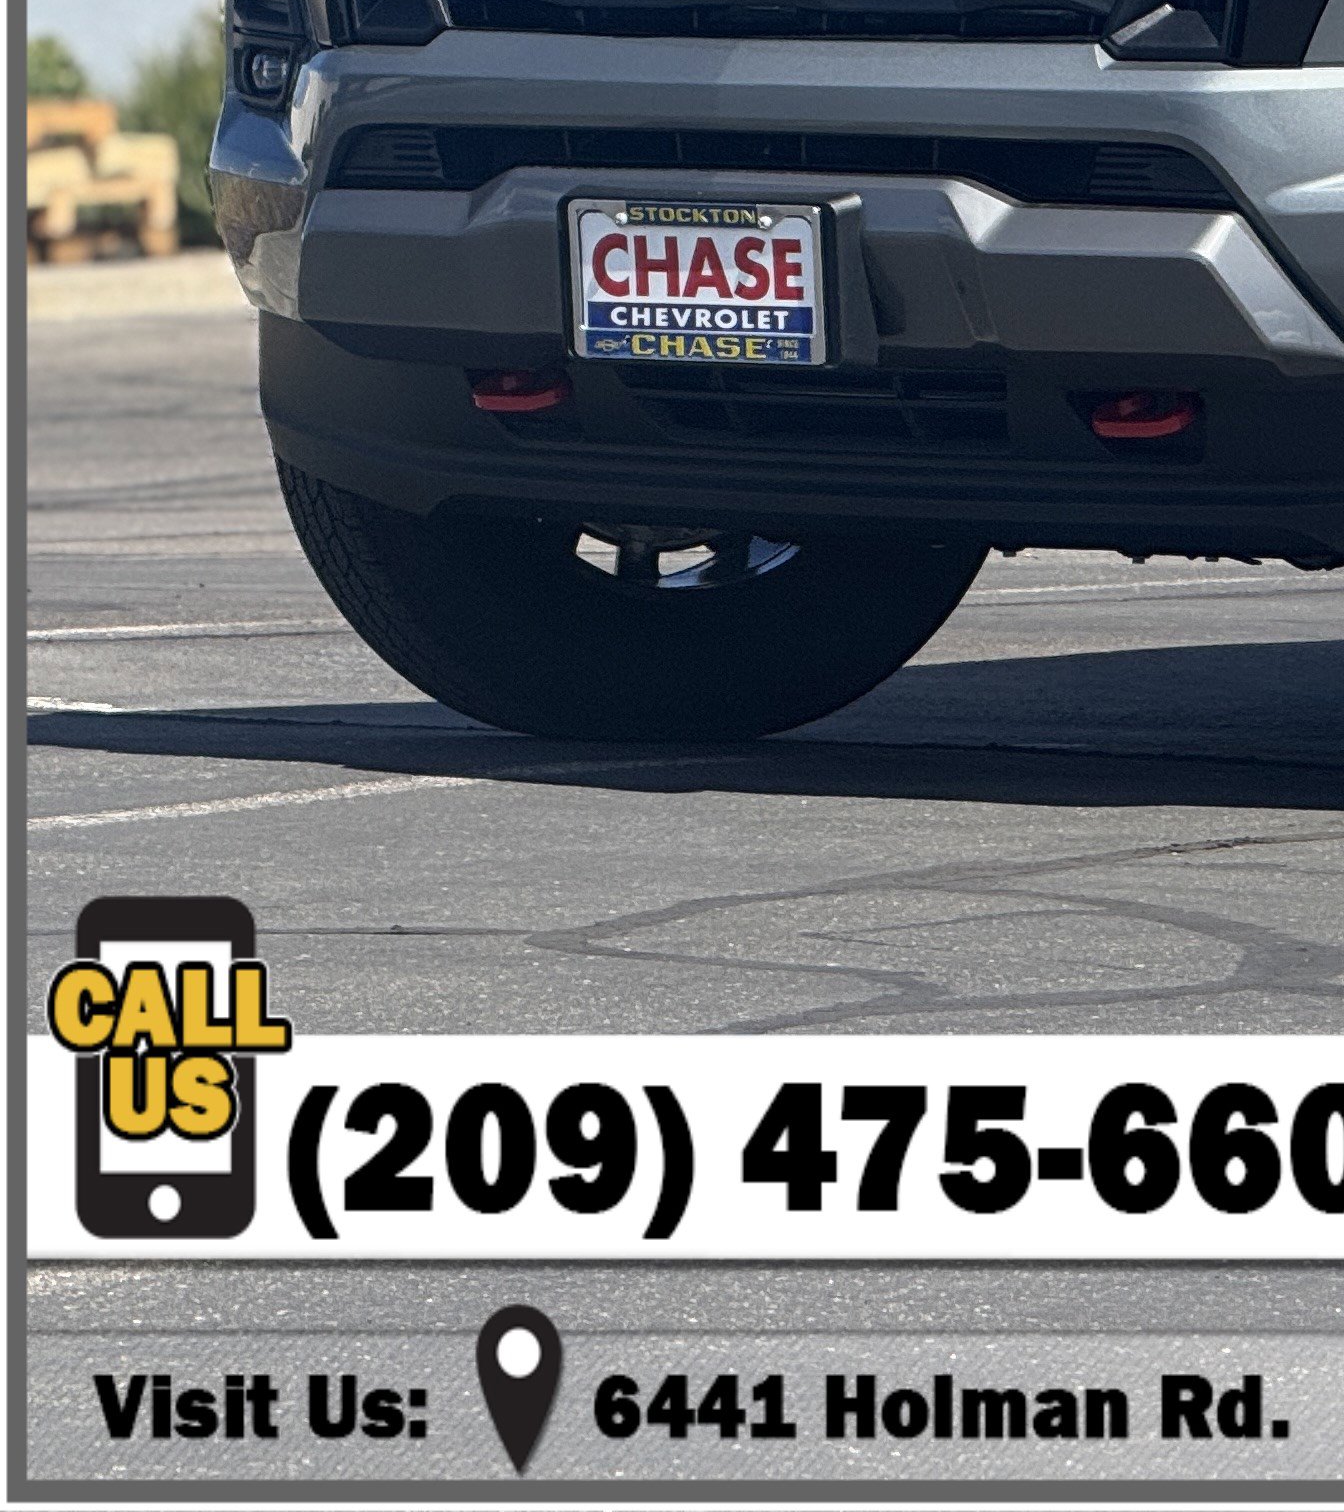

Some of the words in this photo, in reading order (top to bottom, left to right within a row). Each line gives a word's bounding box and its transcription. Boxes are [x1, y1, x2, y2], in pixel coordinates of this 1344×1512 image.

[629, 206, 757, 225] STOCKTON
[592, 233, 804, 301] CHASE
[611, 306, 789, 331] CHEVROLET
[631, 333, 766, 359] CHASE
